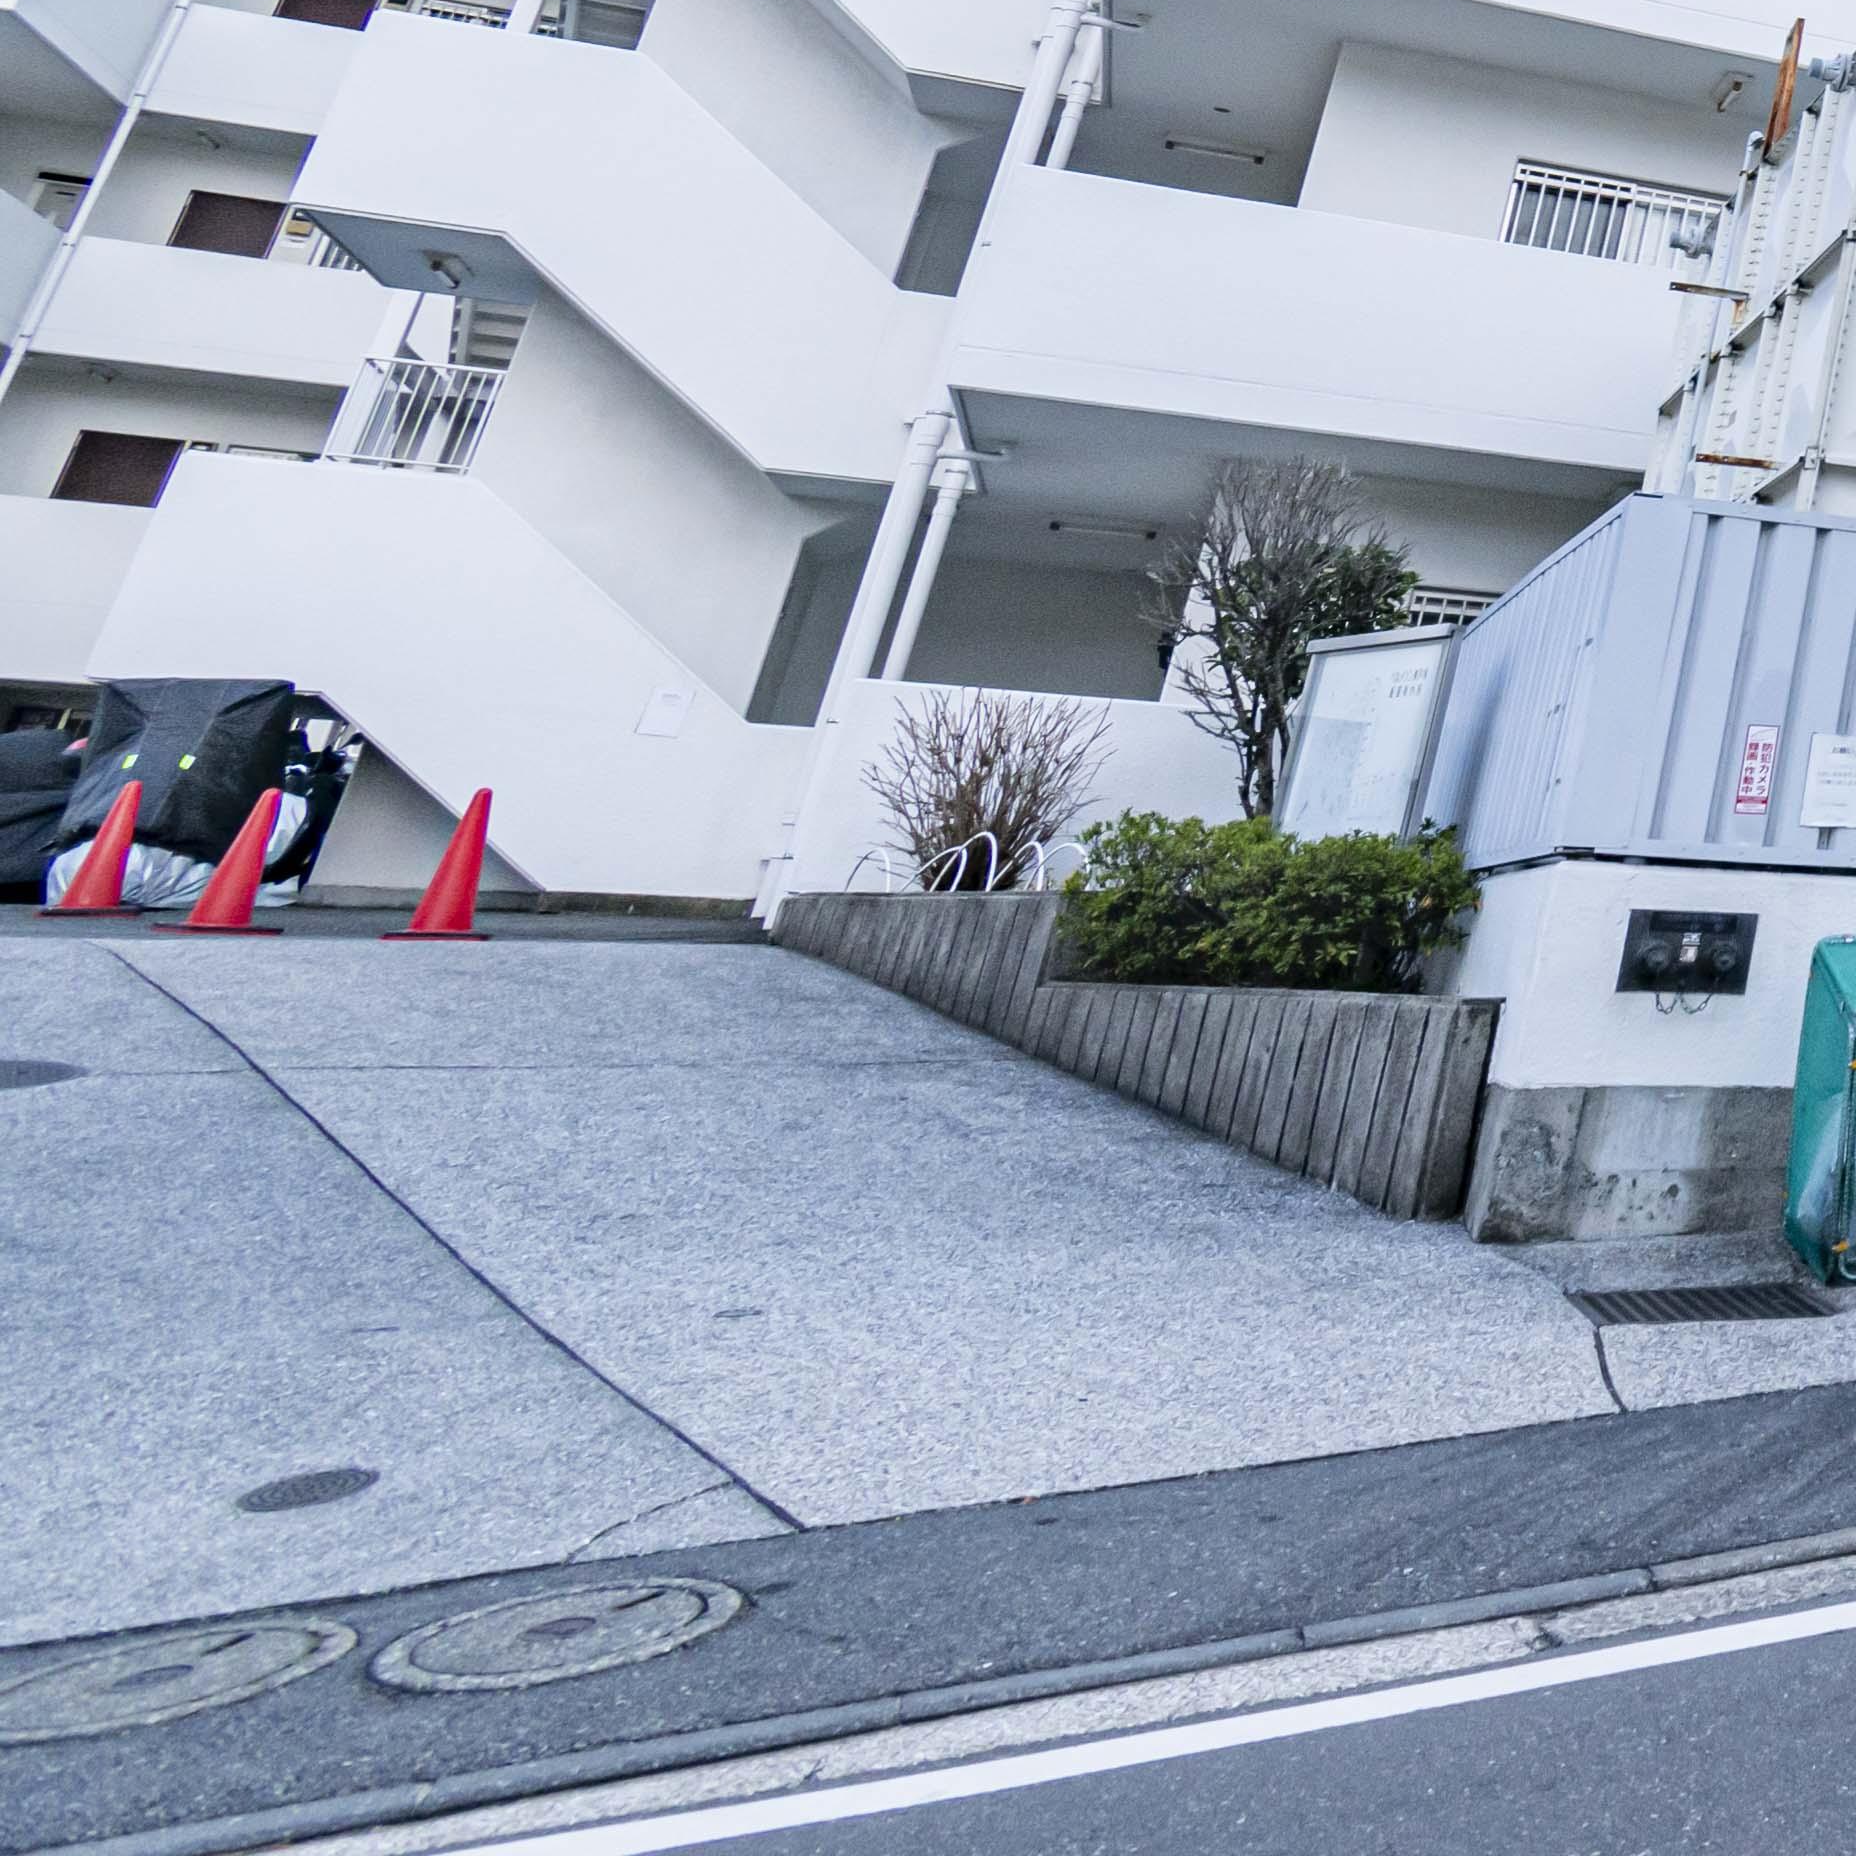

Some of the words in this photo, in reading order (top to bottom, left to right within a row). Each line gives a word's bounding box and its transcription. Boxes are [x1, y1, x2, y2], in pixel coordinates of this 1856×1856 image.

[1755, 742, 1774, 796] 防犯カメラ
